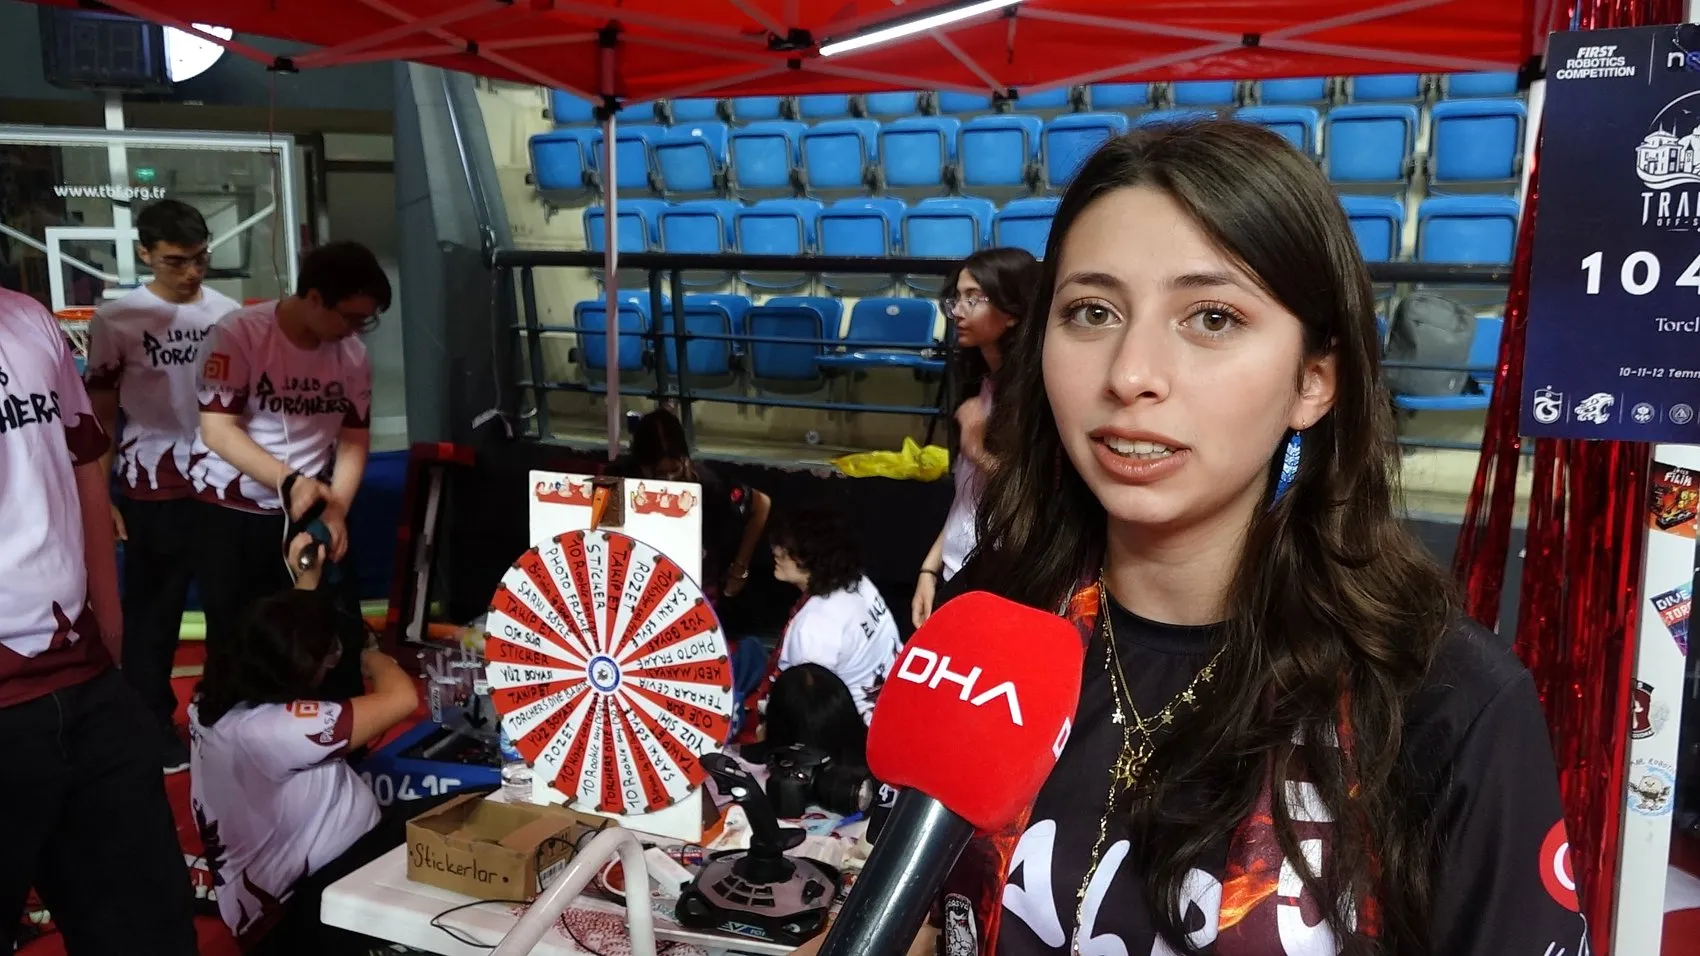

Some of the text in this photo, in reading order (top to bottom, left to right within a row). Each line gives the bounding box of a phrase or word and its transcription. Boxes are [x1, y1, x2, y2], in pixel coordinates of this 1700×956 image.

[1577, 46, 1617, 58] FIRST
[1556, 66, 1635, 80] COMPETITION
[1567, 57, 1626, 69] ROBOTICS
[1641, 192, 1700, 225] TRA
[143, 344, 198, 367] TORC
[1619, 367, 1665, 378] 10-11-12
[566, 538, 583, 558] 10
[544, 546, 572, 590] PHOTO
[566, 593, 591, 635] FRAME
[622, 560, 651, 613] ROZET
[608, 595, 619, 612] ET
[1656, 590, 1691, 610] DIVE
[1665, 602, 1691, 621] TOR
[536, 622, 554, 638] ET
[634, 636, 715, 670] PHOTO FRAME
[897, 646, 1023, 726] DHA
[671, 686, 723, 709] TEKRAR
[648, 723, 665, 740] ET
[542, 722, 576, 766] ROZET
[581, 778, 595, 796] 10
[625, 788, 640, 808] 10
[413, 842, 498, 884] Stickerlar
